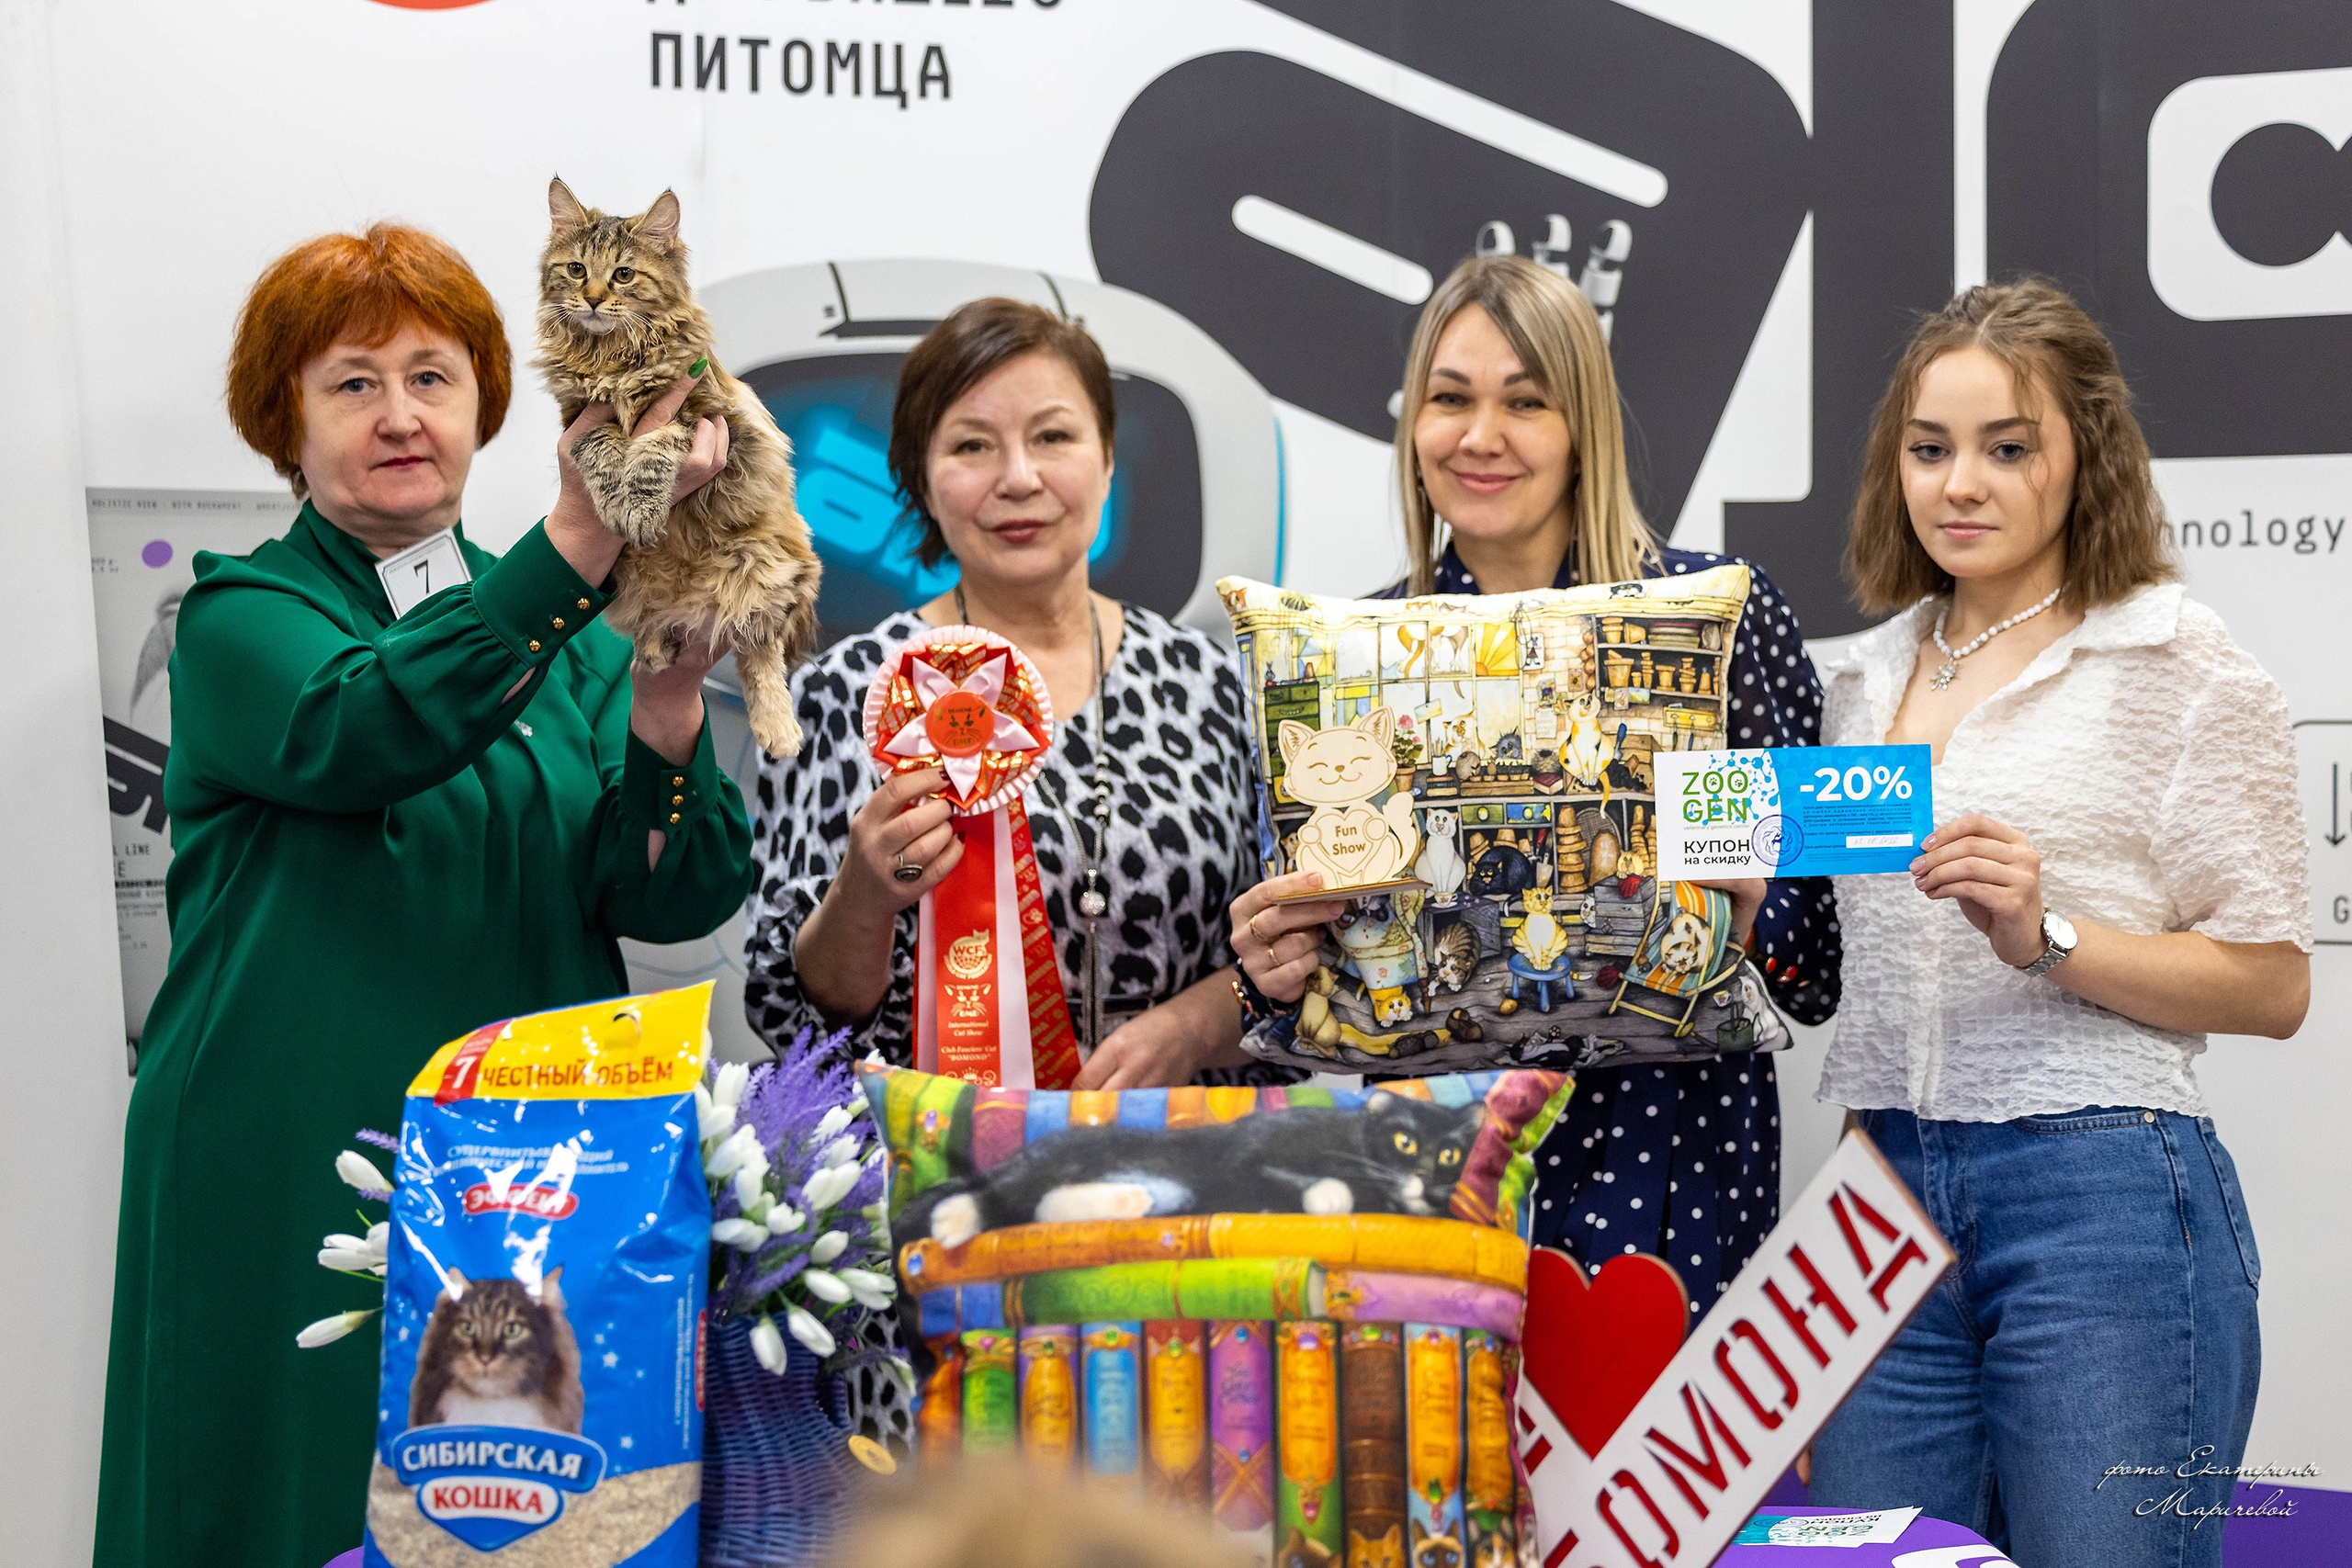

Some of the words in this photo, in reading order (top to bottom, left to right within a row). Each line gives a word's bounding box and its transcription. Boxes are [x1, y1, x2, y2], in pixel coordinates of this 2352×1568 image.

[650, 32, 952, 110] ПИТОМЦА
[413, 558, 429, 594] 7
[1682, 770, 1748, 795] ZOO
[1799, 765, 1914, 802] -20%
[1683, 797, 1747, 823] GEN
[1335, 825, 1358, 838] Fun
[1332, 842, 1366, 856] Show
[1684, 839, 1750, 854] КУПОН
[1684, 857, 1700, 865] на
[1703, 855, 1751, 866] скидку
[953, 945, 982, 954] WCF
[482, 1057, 588, 1088] ЧЕСТНЫЙ
[596, 1056, 674, 1085] ОБЪЁМ
[401, 1440, 584, 1480] СИБИРСКАЯ
[433, 1485, 545, 1516] КОШКА
